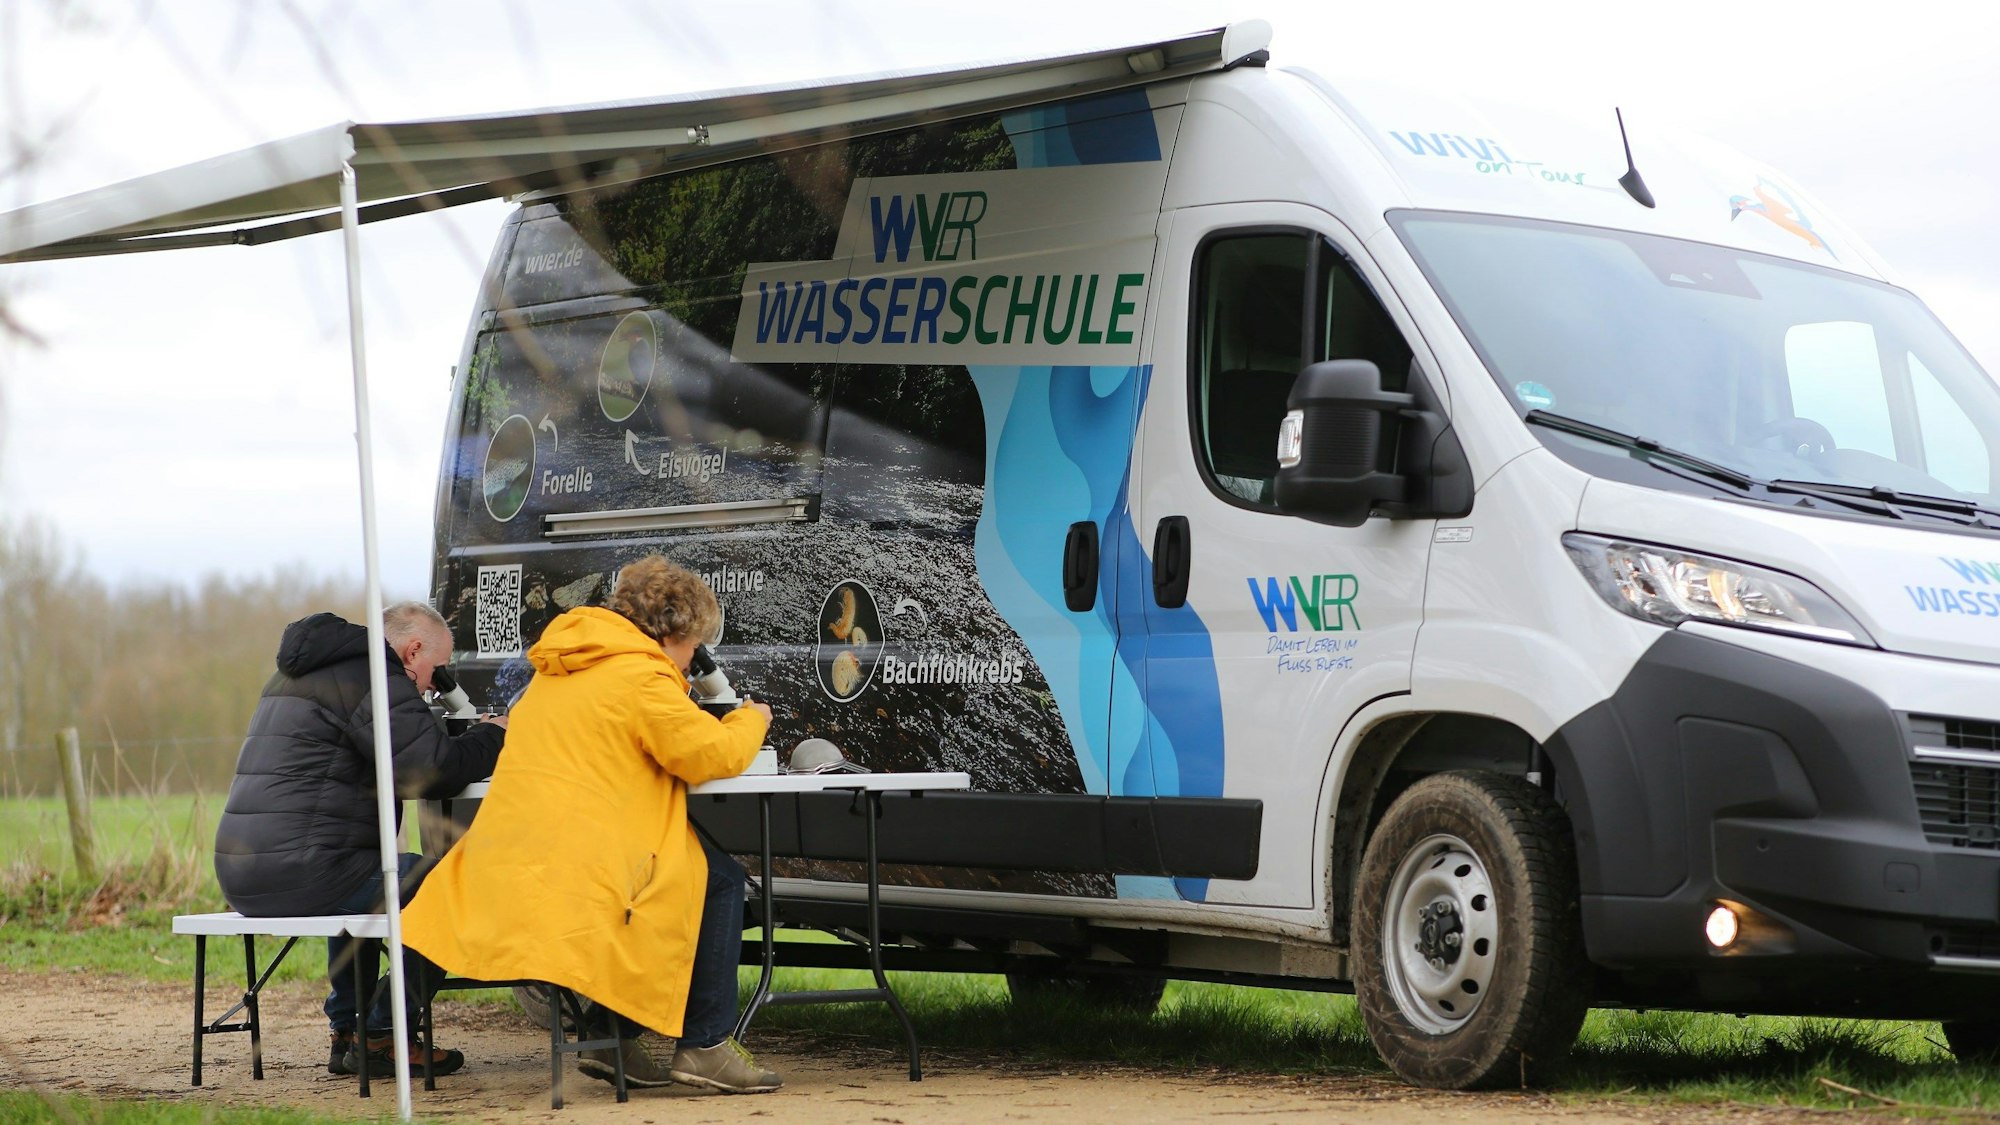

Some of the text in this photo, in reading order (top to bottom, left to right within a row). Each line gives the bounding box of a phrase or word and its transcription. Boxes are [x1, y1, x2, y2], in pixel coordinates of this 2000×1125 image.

[1388, 131, 1513, 163] WiVi
[1475, 160, 1586, 185] on Tour
[870, 191, 988, 263] WVER
[525, 244, 583, 274] wver.de
[756, 273, 1145, 345] WASSERSCHULE
[658, 446, 727, 484] Eisvogel
[541, 466, 593, 496] Forelle
[1937, 556, 2000, 585] WV
[1247, 574, 1361, 632] WVER
[1267, 635, 1358, 654] DAMIT LEBEN IM
[882, 653, 1025, 685] Bachflohkrebs
[1278, 653, 1312, 675] FLUSS
